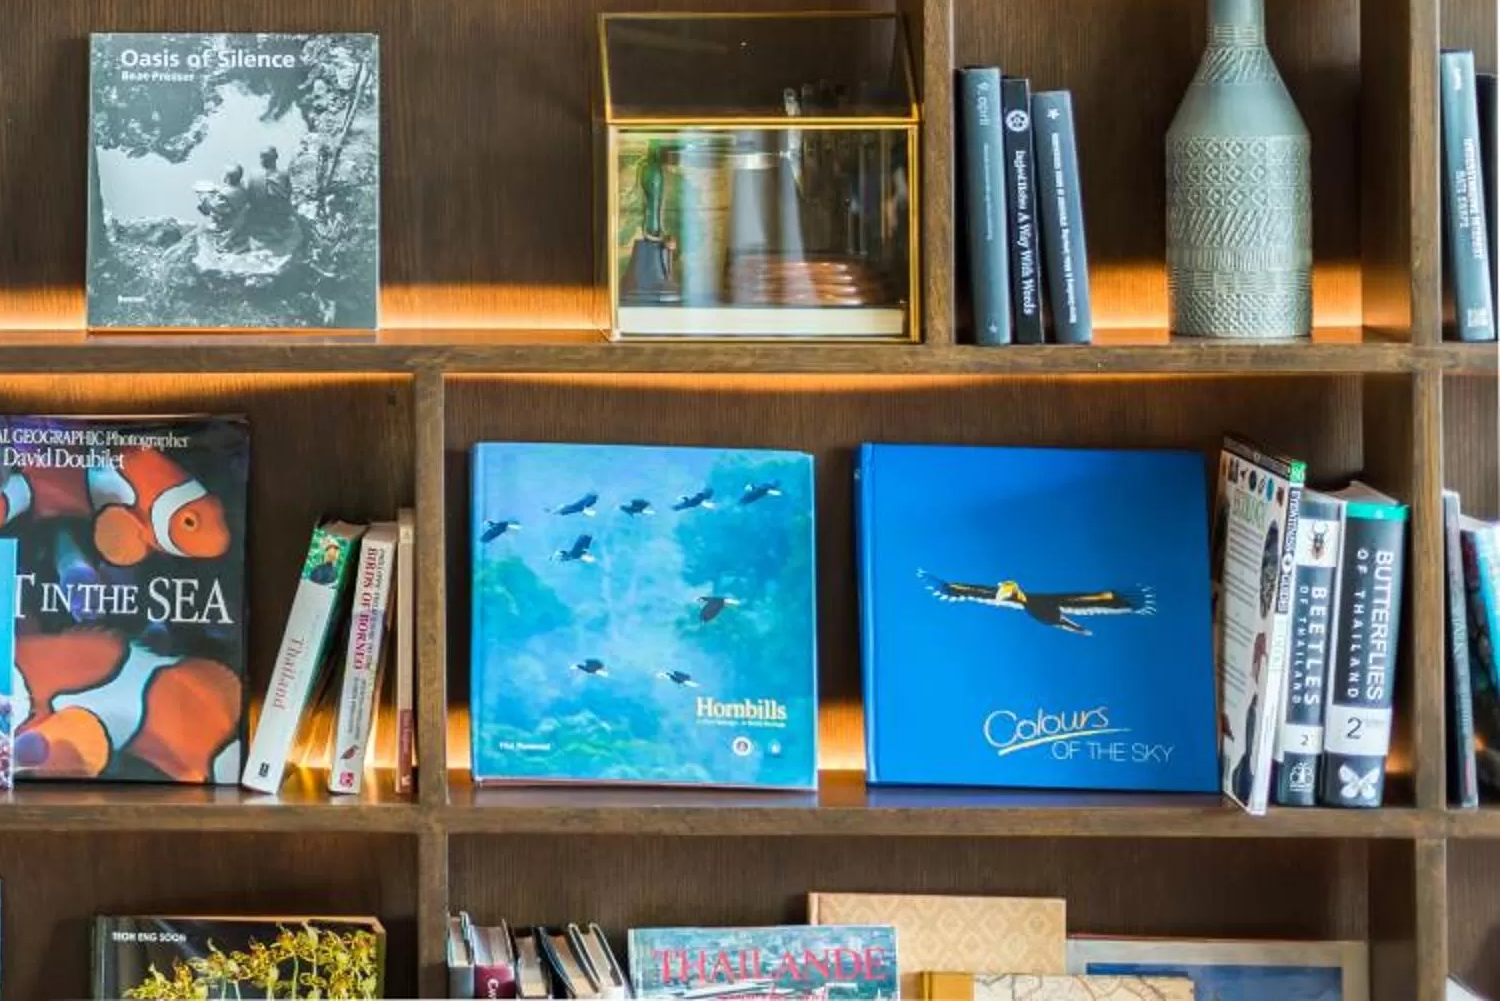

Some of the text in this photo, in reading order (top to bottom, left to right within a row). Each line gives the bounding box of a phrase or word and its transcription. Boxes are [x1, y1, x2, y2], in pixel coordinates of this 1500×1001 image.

[121, 48, 296, 68] Oasis of Silence
[1017, 224, 1032, 248] Way
[1022, 279, 1037, 316] Words
[12, 428, 104, 447] GEOGRAPHIC
[106, 430, 190, 450] Photographer
[3, 448, 124, 469] David Doubilet
[363, 548, 377, 588] BIRDS
[41, 585, 72, 613] IN
[77, 585, 139, 614] THE
[147, 578, 234, 624] SEA
[361, 591, 373, 609] OF
[353, 611, 371, 671] BORNEO
[1347, 550, 1369, 698] OF THAILAND
[1367, 551, 1394, 700] BUTTERFLIES
[1292, 585, 1309, 704] OF THAILAND
[1304, 587, 1328, 705] BEETLES
[272, 637, 307, 710] Thailand
[696, 697, 788, 721] Hornbills
[983, 707, 1110, 749] Colours
[1300, 734, 1310, 747] 2
[1347, 717, 1362, 739] 2
[1051, 743, 1175, 762] OF THE SKY
[651, 947, 888, 984] THAILANDE
